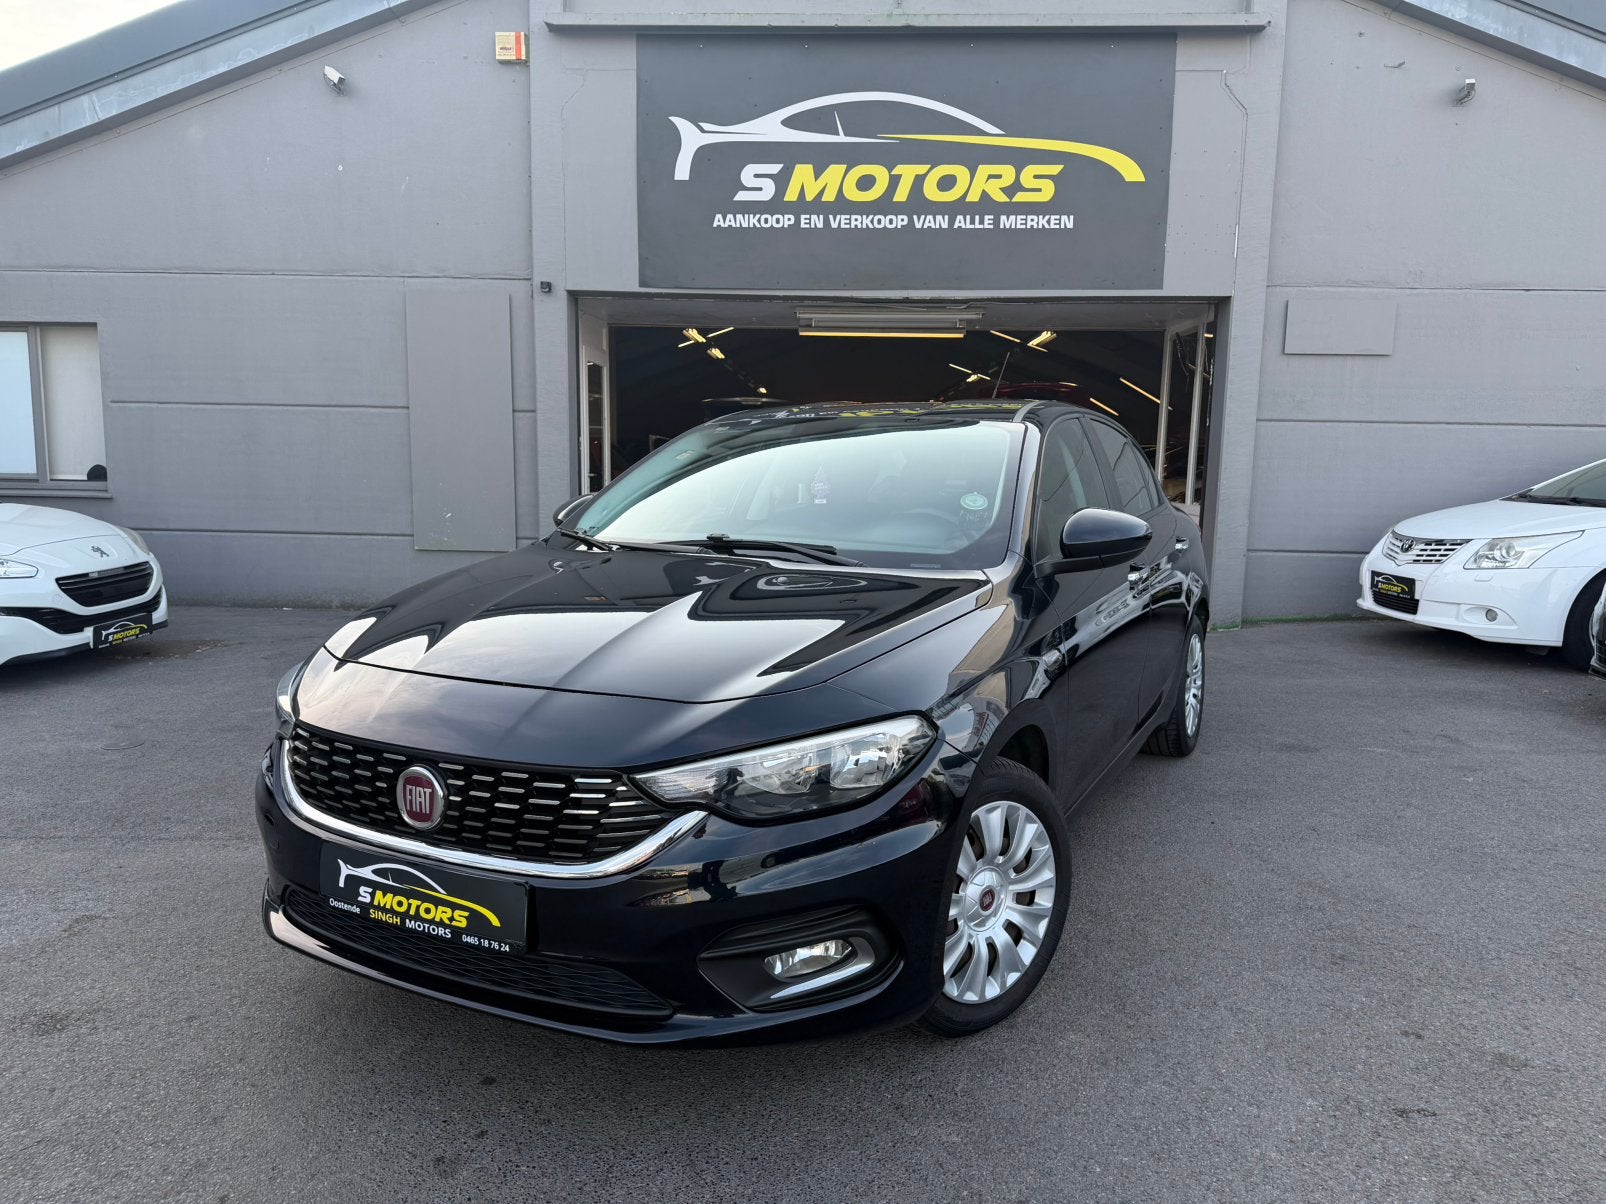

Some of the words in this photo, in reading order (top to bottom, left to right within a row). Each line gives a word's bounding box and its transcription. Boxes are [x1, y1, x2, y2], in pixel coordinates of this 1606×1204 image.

[733, 164, 784, 201] S
[784, 164, 1064, 202] MOTORS
[713, 214, 795, 228] AANKOOP
[800, 214, 824, 229] EN
[829, 214, 908, 229] VERKOOP
[913, 215, 949, 229] VAN
[953, 215, 994, 229] ALLE
[1000, 215, 1074, 229] MERKEN
[405, 784, 433, 814] FIAT
[329, 898, 361, 914] Oostende
[369, 908, 400, 926] SINGH
[405, 918, 452, 938] MOTORS
[462, 934, 479, 945] 0465
[480, 938, 489, 948] 18
[490, 940, 499, 950] 76
[500, 943, 510, 952] 24
[357, 886, 373, 904] S
[373, 890, 470, 928] MOTORS
